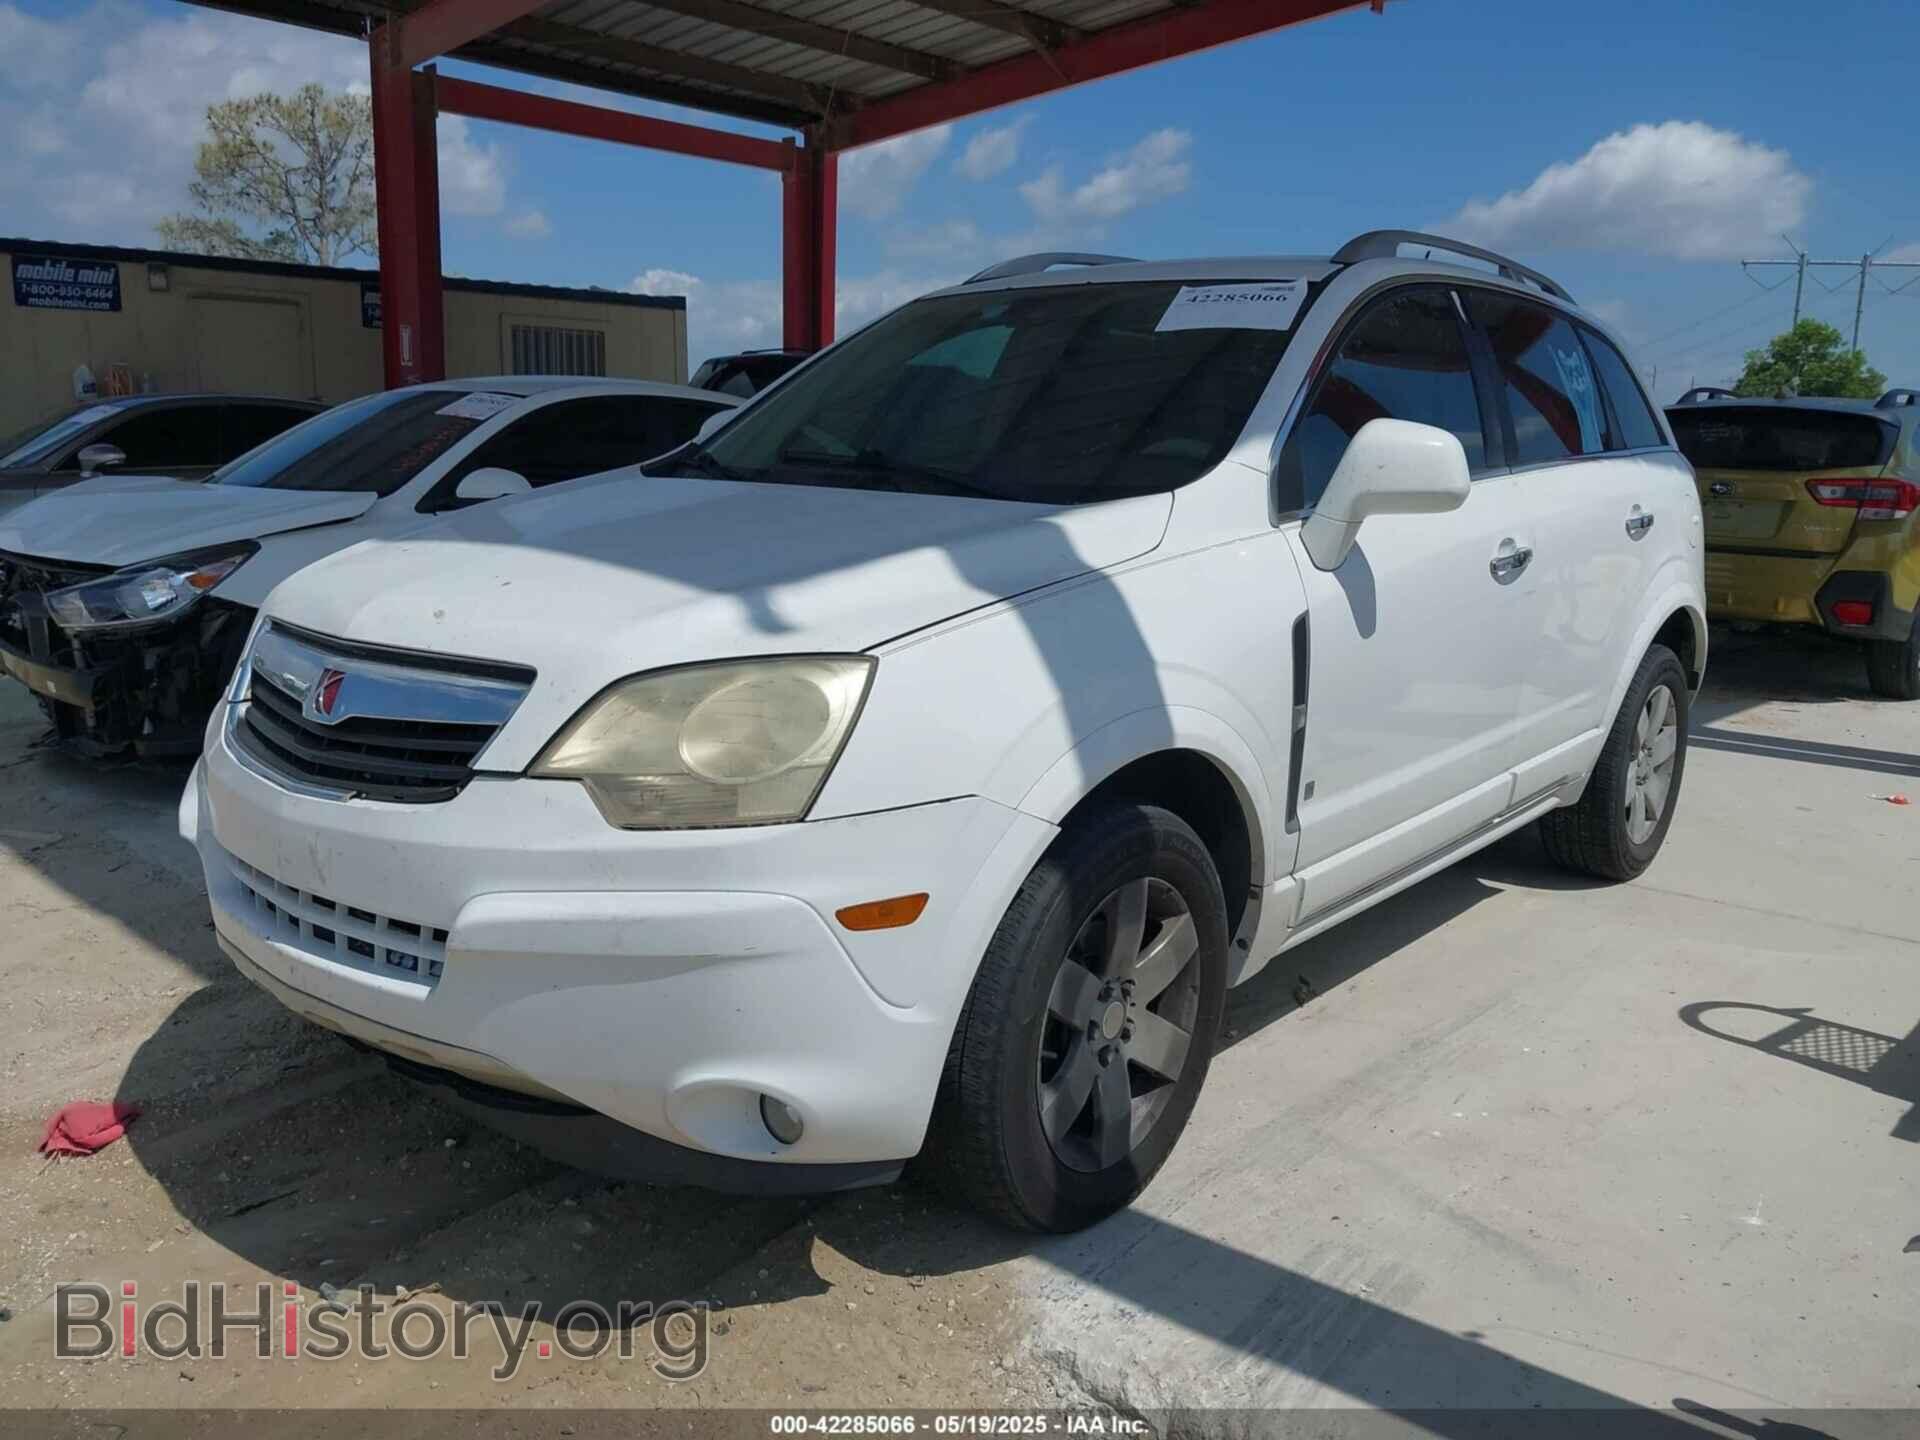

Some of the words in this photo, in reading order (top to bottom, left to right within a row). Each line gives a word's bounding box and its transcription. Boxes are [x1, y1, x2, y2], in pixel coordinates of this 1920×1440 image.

[16, 259, 74, 281] mobile
[78, 267, 115, 284] mini
[28, 297, 110, 309] mobilemini.com
[1184, 293, 1288, 302] 42285066
